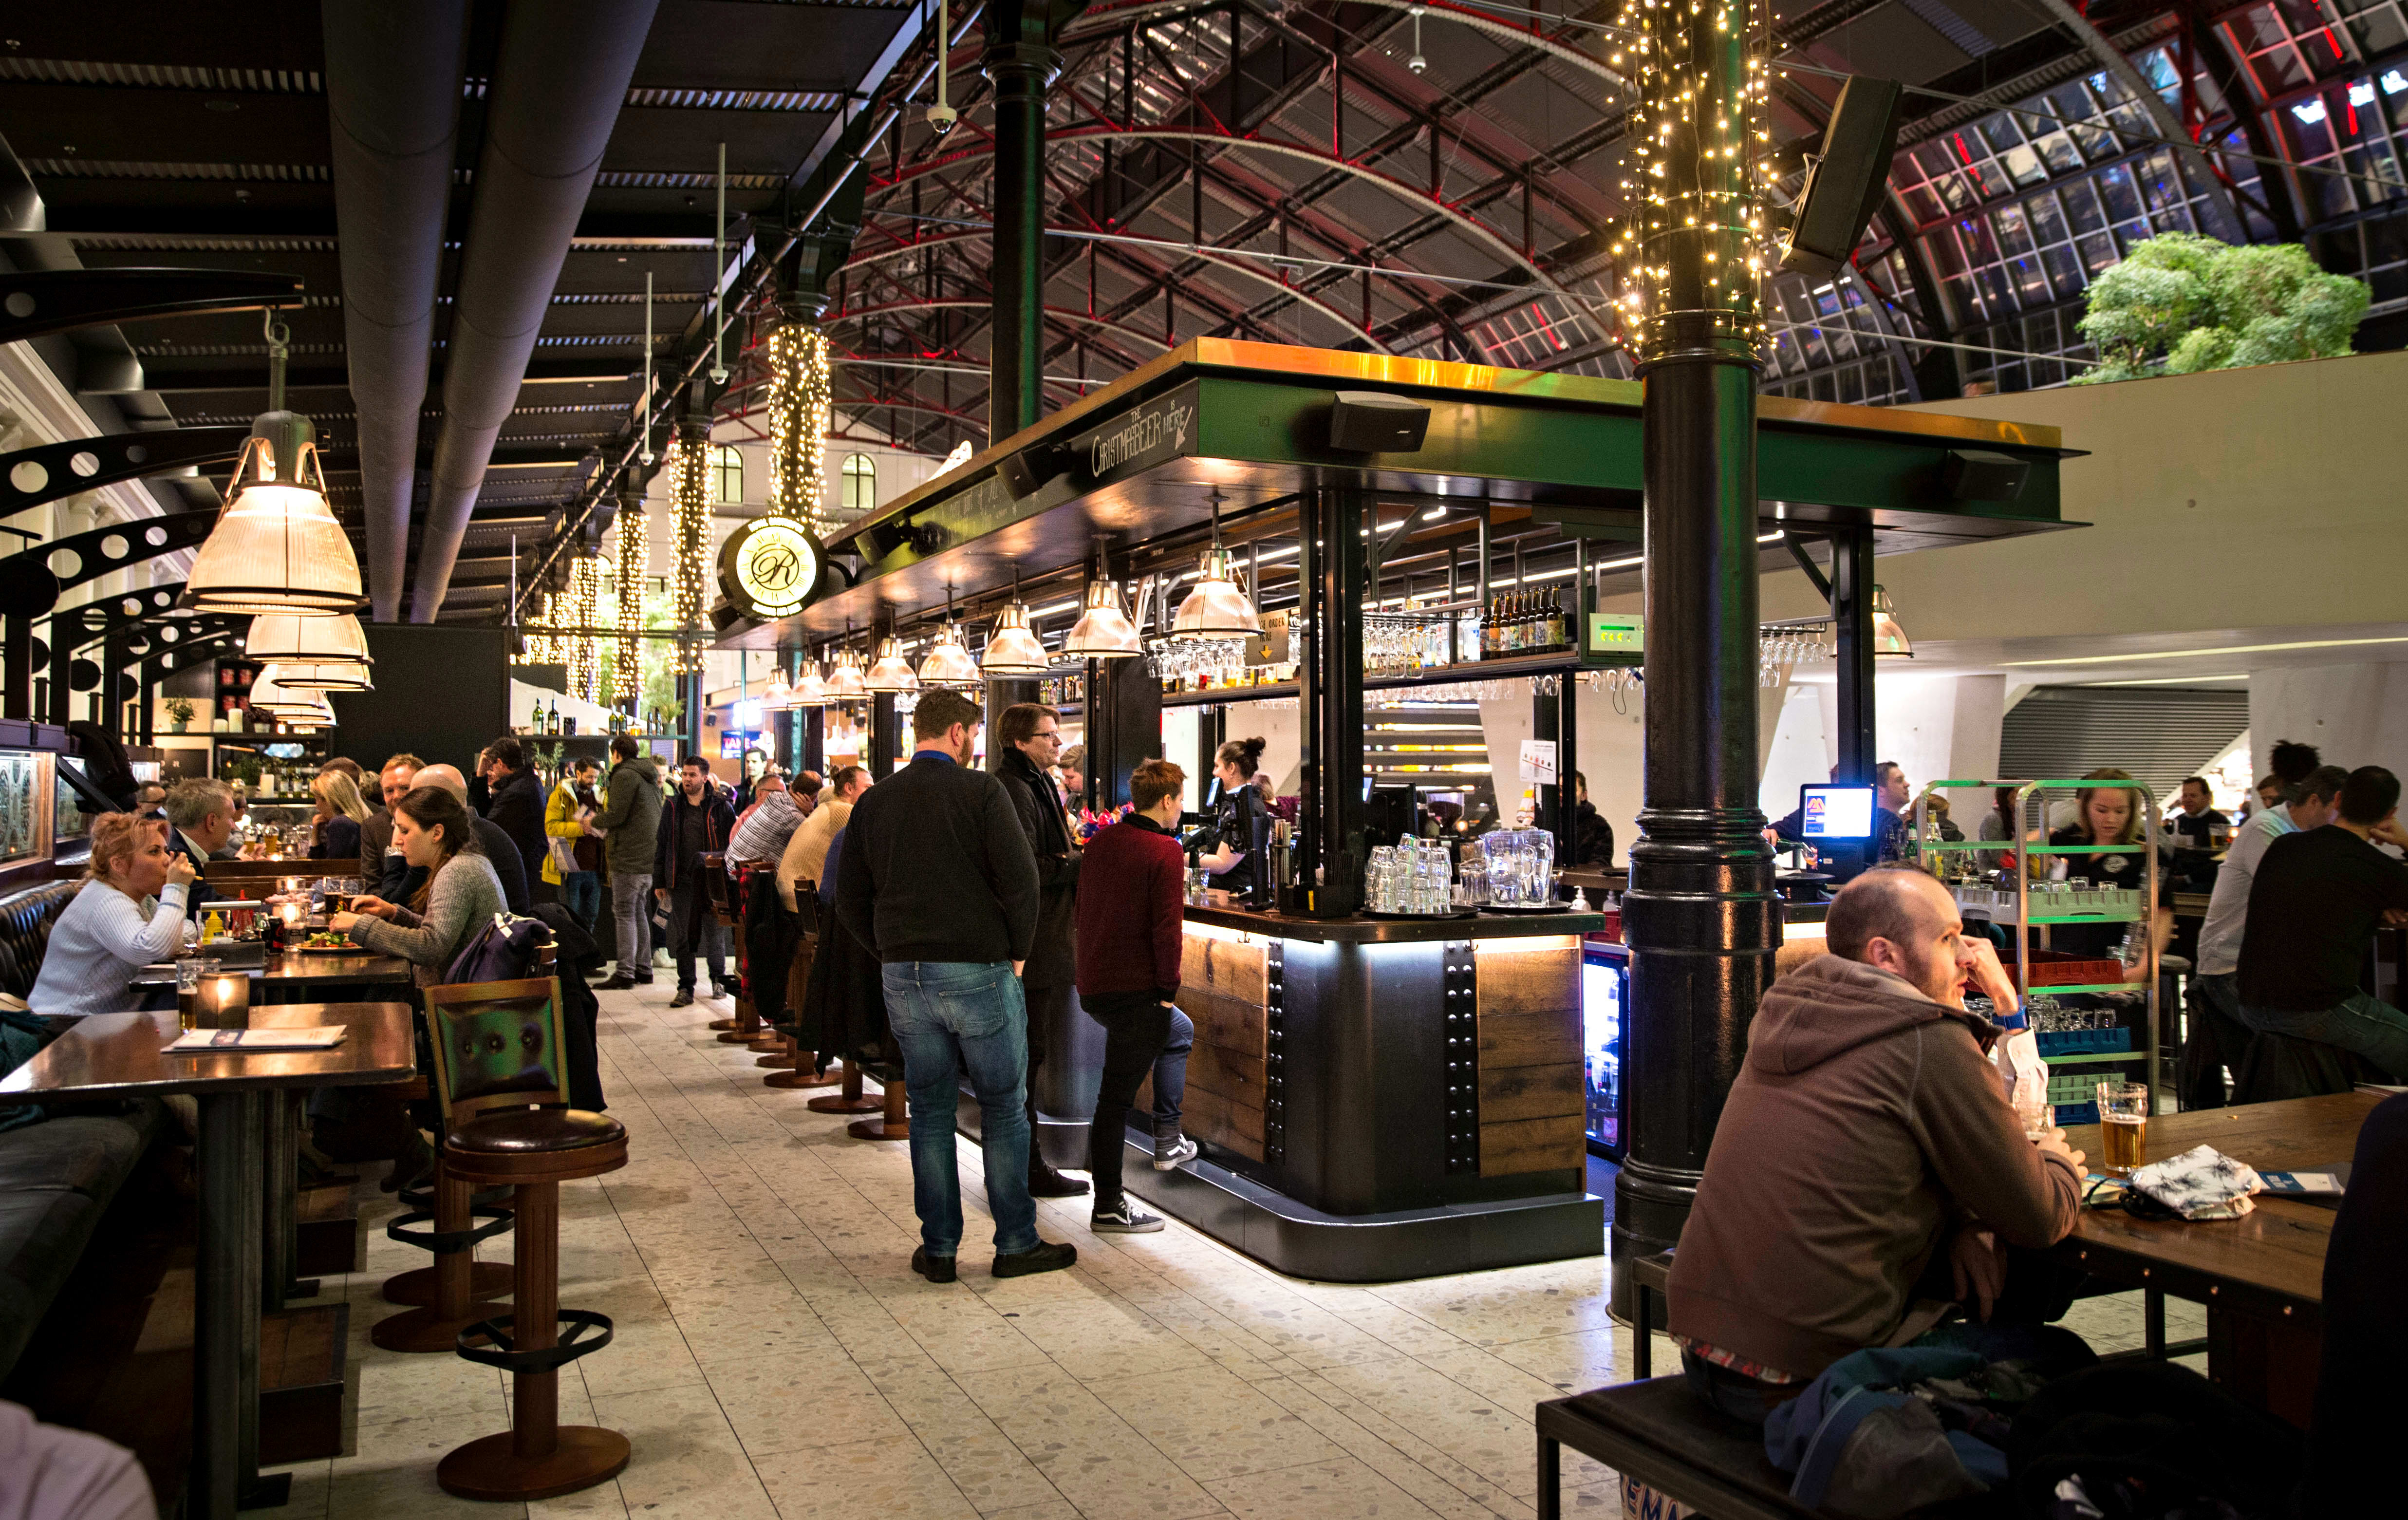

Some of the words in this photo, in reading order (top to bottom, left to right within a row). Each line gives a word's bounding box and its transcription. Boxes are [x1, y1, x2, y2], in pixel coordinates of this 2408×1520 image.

[1130, 407, 1141, 423] THE
[1163, 406, 1186, 435] HERE
[1269, 617, 1285, 629] ORDER
